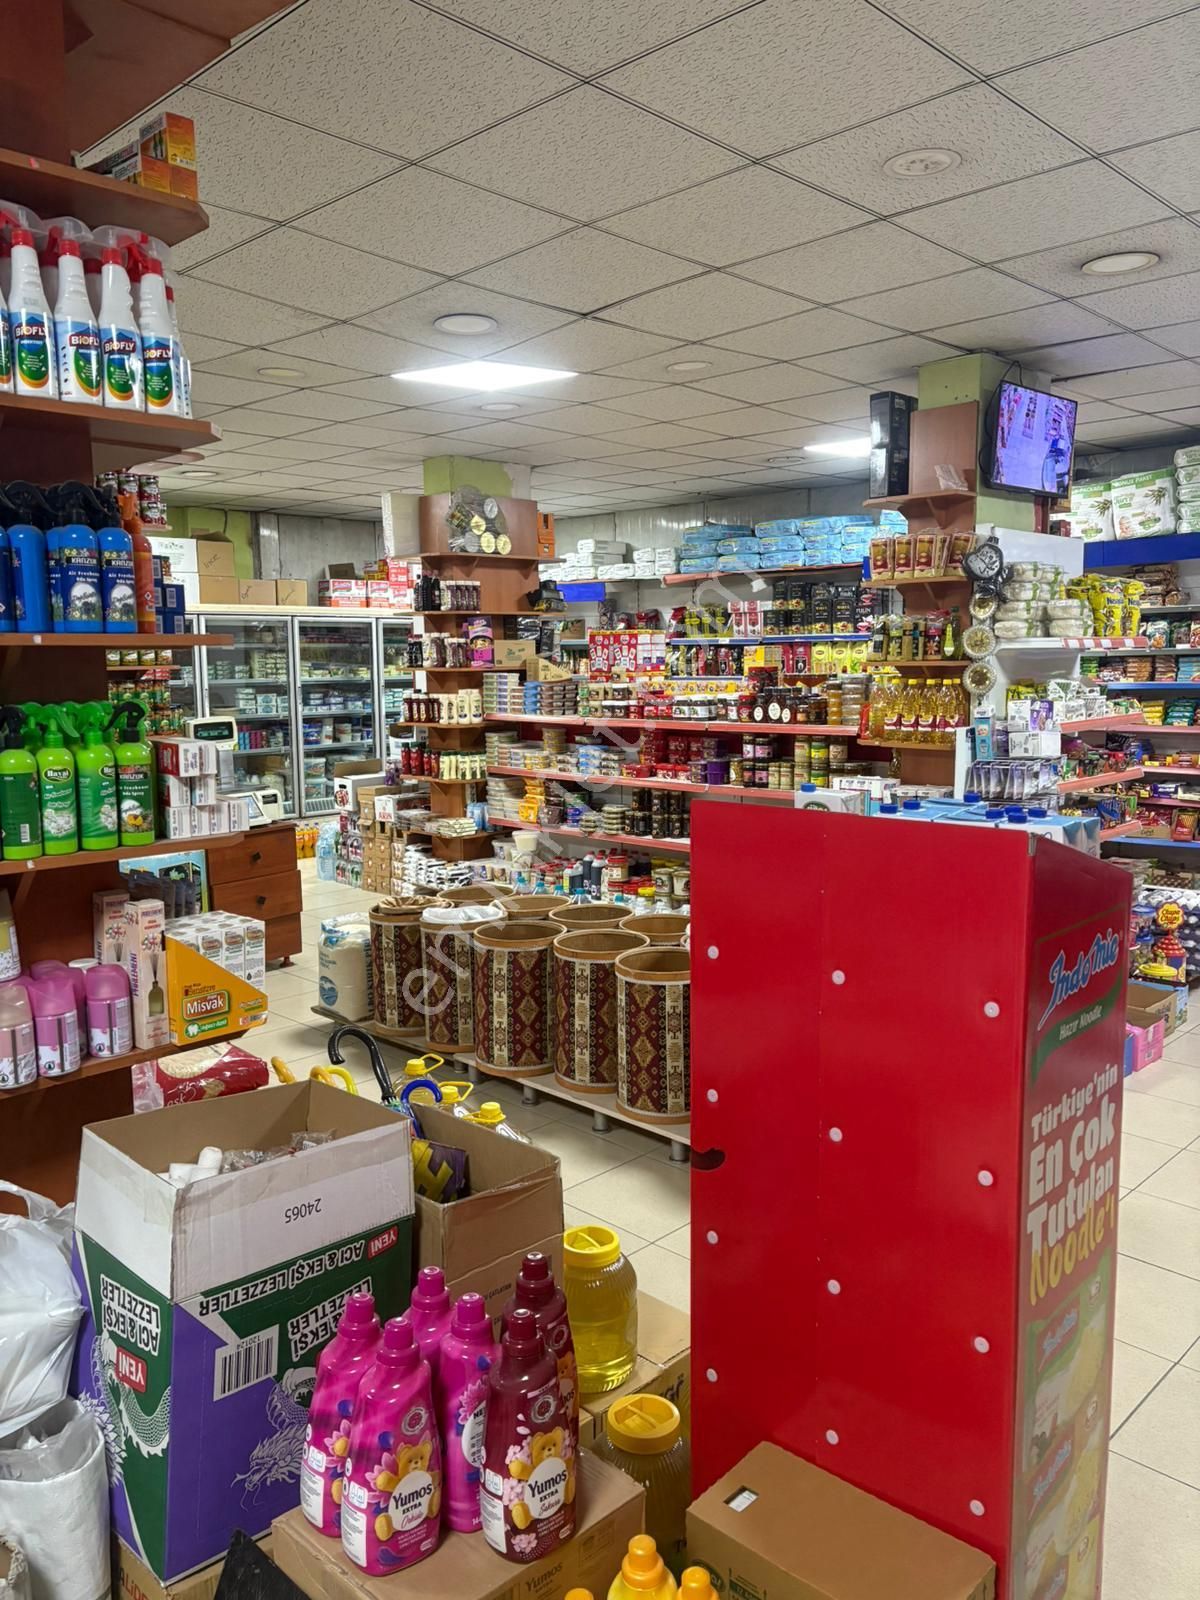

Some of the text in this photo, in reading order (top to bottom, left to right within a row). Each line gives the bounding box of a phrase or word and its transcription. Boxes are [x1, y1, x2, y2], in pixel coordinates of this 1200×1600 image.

[186, 997, 224, 1015] Misvak
[1031, 1063, 1118, 1143] Türkiye'nin
[1028, 1095, 1116, 1206] En Çok
[285, 1198, 322, 1224] 24065
[1027, 1156, 1114, 1258] Tutulan
[200, 1231, 397, 1317] YENİ ACI & EKŞİ LEZZETLER
[101, 1277, 160, 1330] LEZZETLER
[103, 1301, 159, 1353] ACI & EKŞİ
[293, 1325, 329, 1360] EKŞİ
[119, 1351, 145, 1386] YENİ
[392, 1483, 433, 1511] Yumos
[528, 1469, 567, 1498] Yumos
[540, 1489, 559, 1502] EXTRA
[402, 1501, 422, 1515] EXTRA
